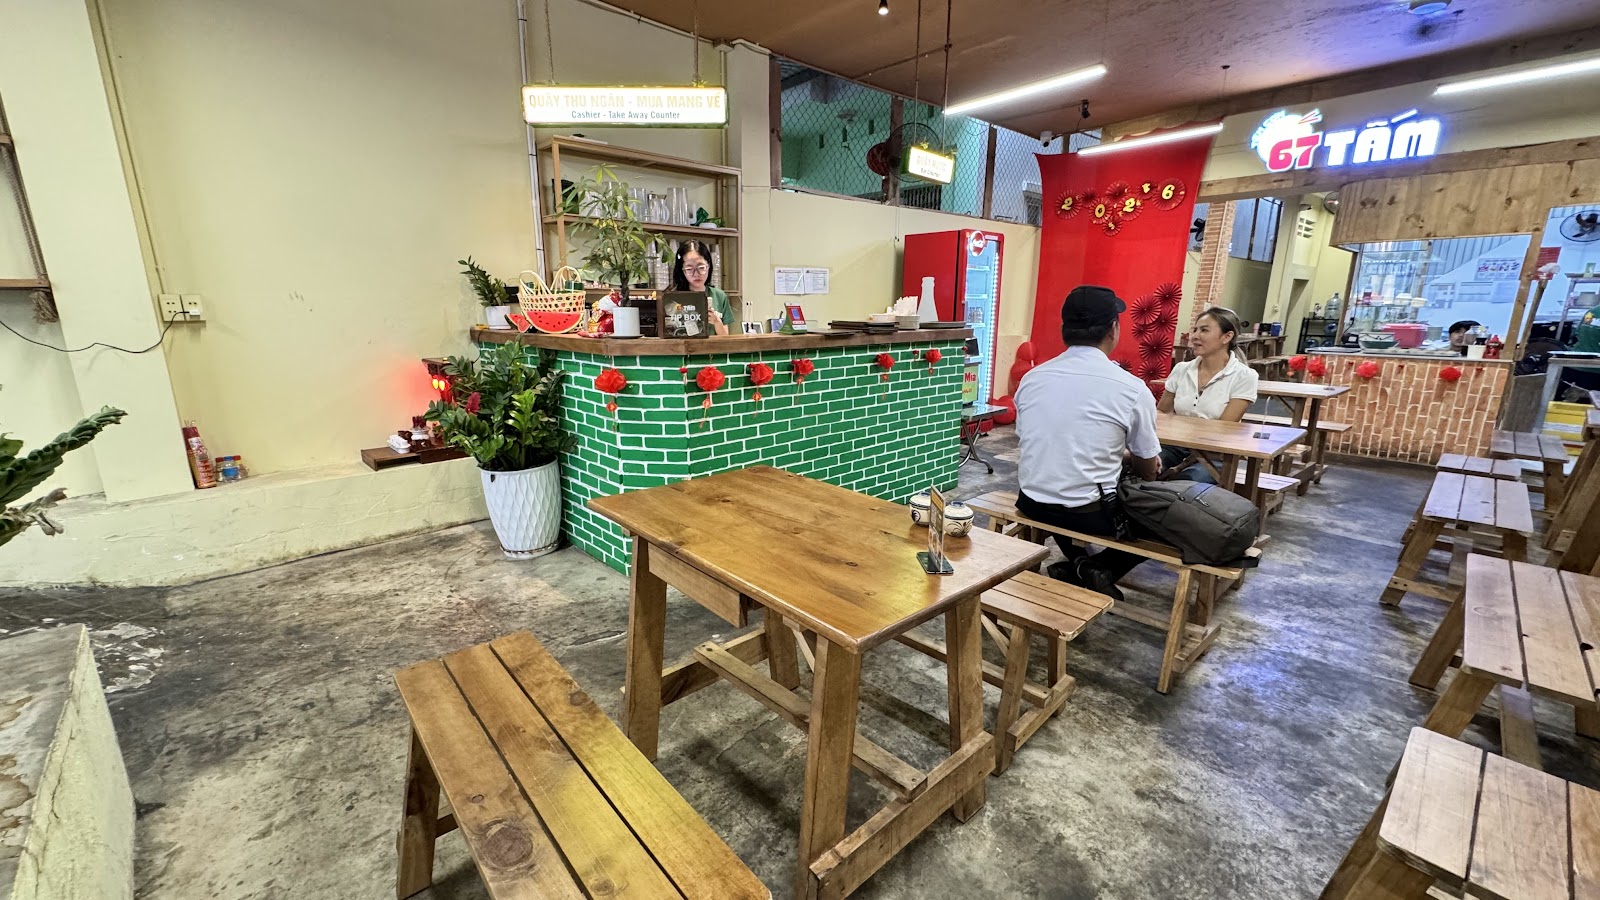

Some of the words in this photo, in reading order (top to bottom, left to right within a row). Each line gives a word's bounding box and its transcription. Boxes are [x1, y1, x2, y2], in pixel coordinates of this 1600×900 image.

[564, 95, 587, 107] THU
[637, 95, 664, 108] MUA
[666, 95, 703, 108] MANG
[571, 110, 601, 119] Cashier
[608, 110, 626, 119] Take
[627, 110, 648, 120] Away
[650, 110, 680, 119] Counter
[1267, 133, 1322, 172] 67
